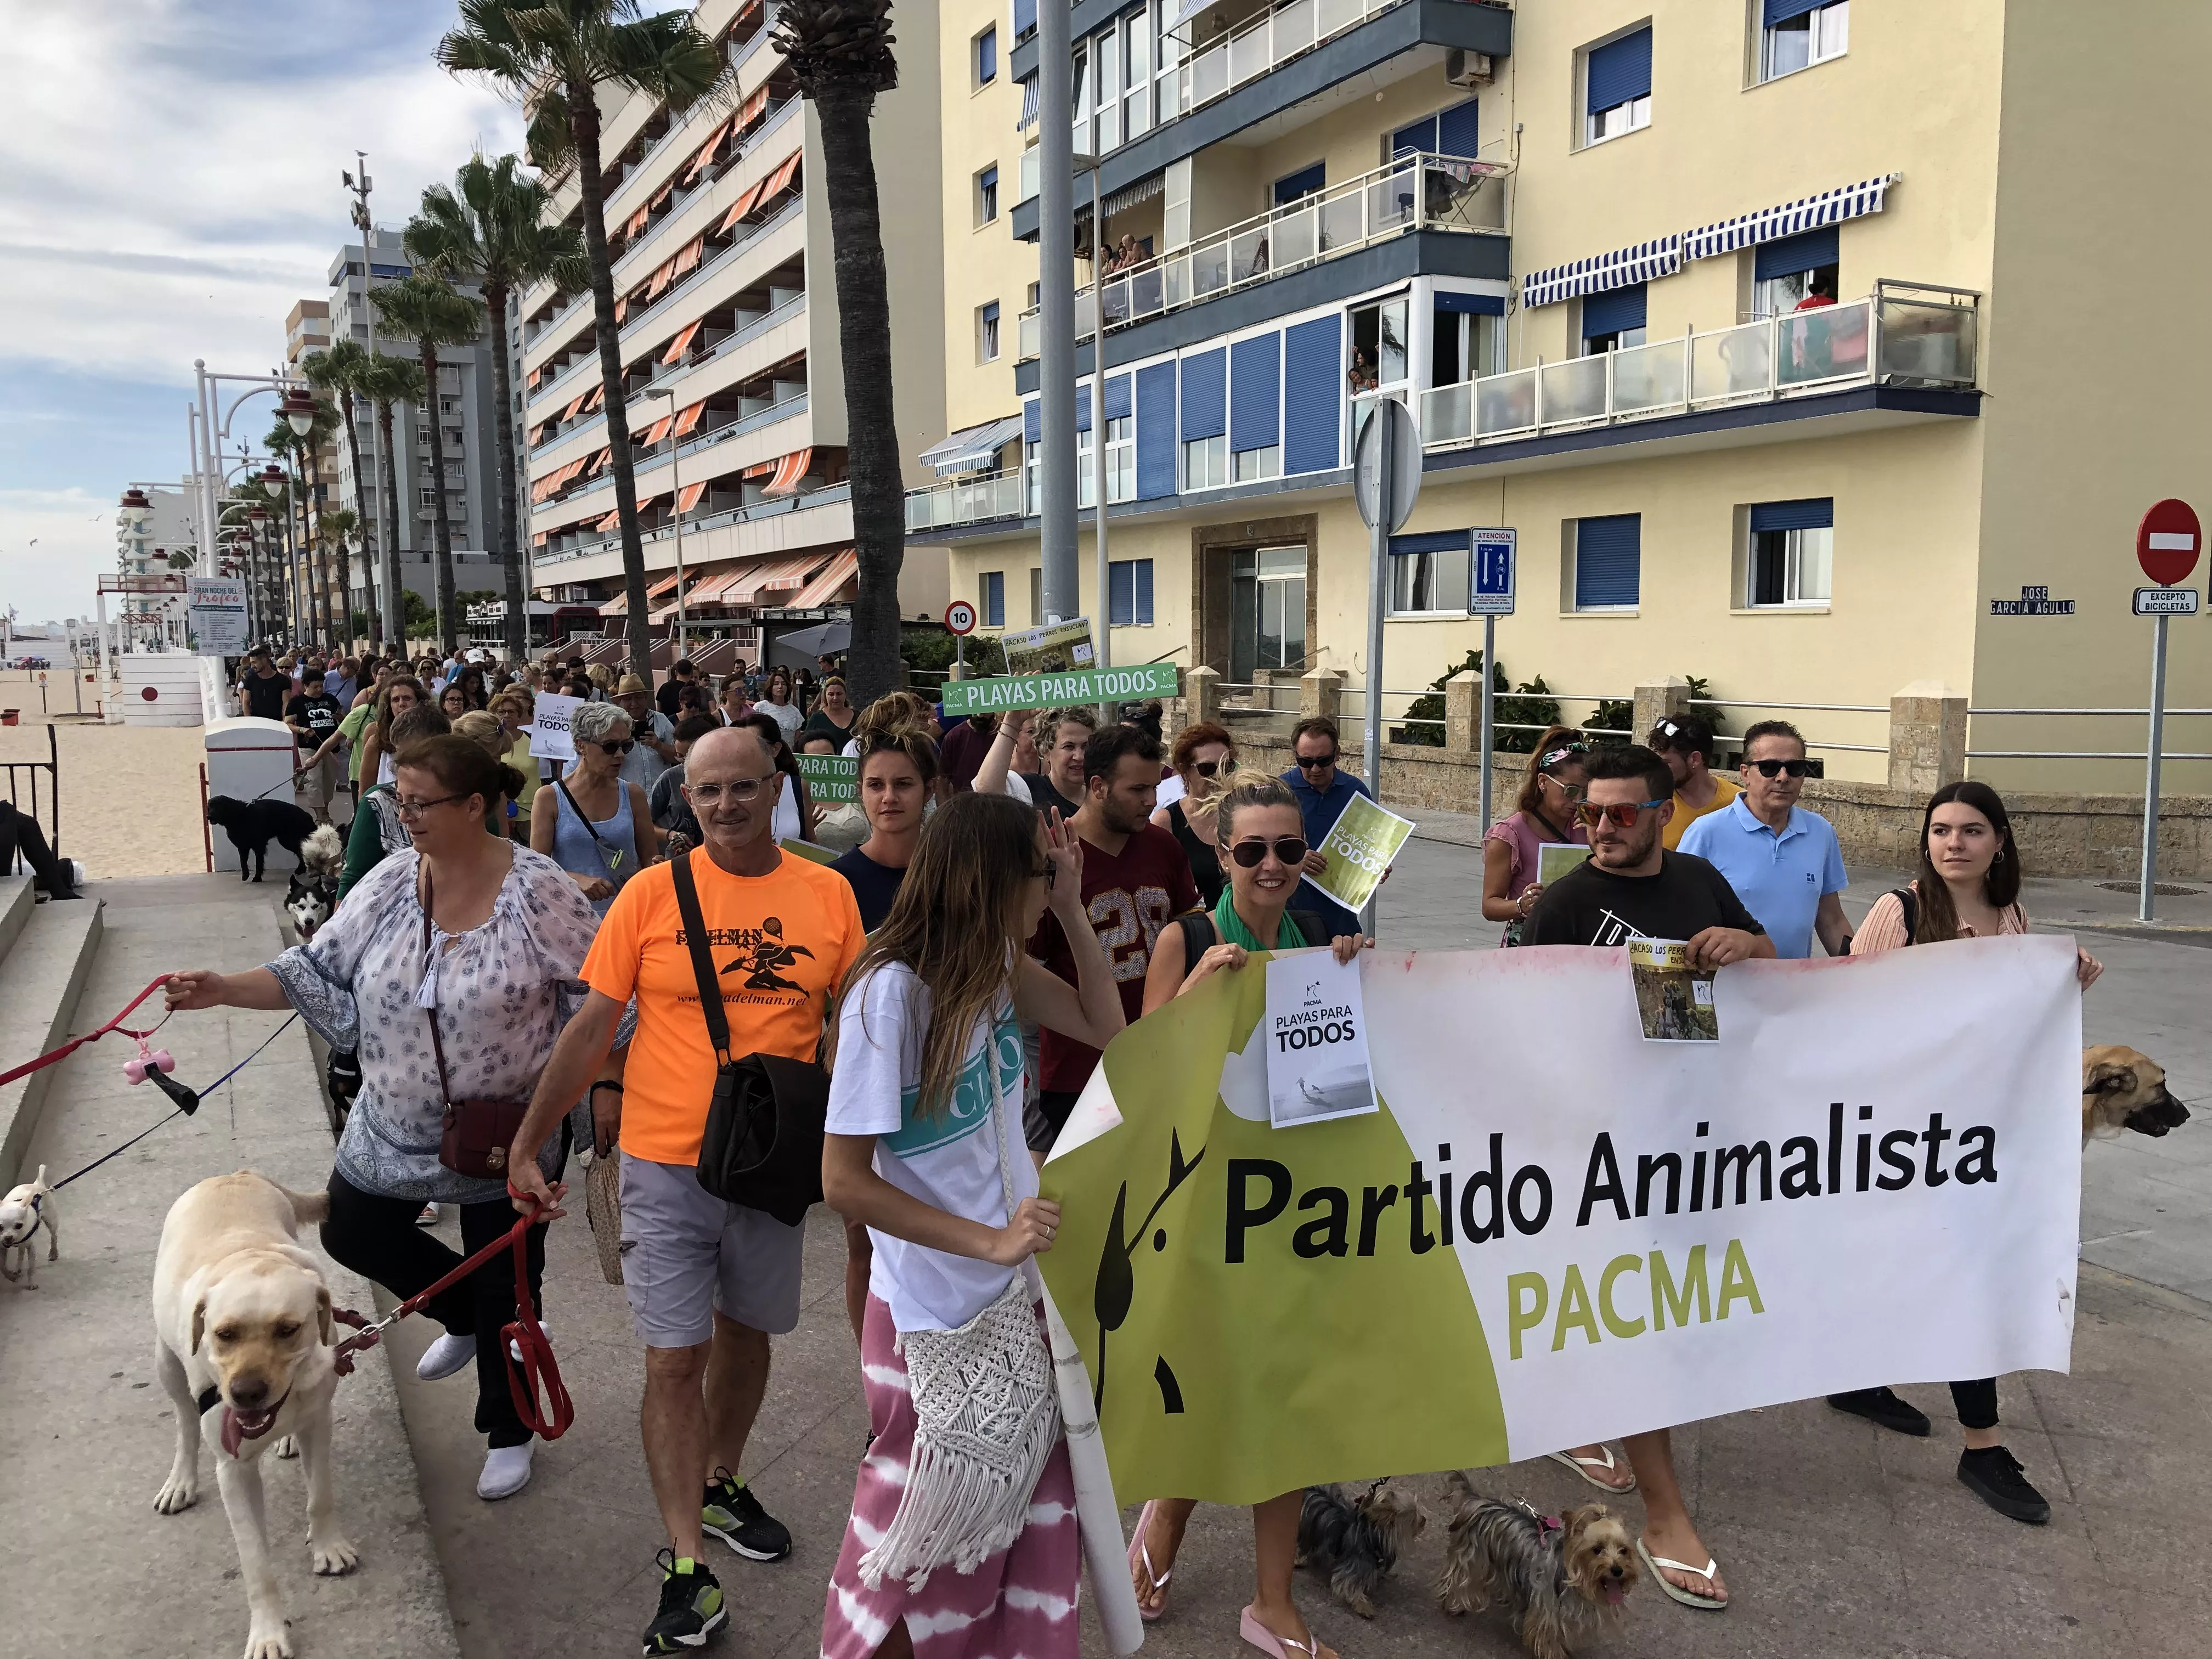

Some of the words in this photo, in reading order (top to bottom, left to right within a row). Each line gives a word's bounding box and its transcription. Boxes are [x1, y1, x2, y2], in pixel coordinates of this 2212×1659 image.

[2022, 588, 2047, 599] JOSE
[1990, 602, 2029, 614] GARCIA
[2036, 601, 2074, 614] AGULLO
[953, 612, 968, 624] 10
[1039, 629, 1058, 639] PERROS
[967, 681, 1036, 708] PLAYAS
[1041, 676, 1092, 701] PARA
[1094, 669, 1156, 696] TODOS
[539, 713, 561, 721] PLAYAS
[538, 719, 570, 732] TODO
[832, 760, 857, 776] TOD
[810, 782, 827, 798] RA
[831, 783, 856, 799] TOD
[1337, 825, 1369, 850] PLAYAS
[1367, 846, 1389, 862] PARA
[1330, 833, 1384, 874] TODOS
[1630, 940, 1653, 954] ¿ACASO
[1655, 945, 1666, 955] LOS
[1668, 946, 1686, 956] PERR
[1304, 998, 1322, 1007] PACMA
[1276, 1011, 1318, 1029] PLAYAS
[1321, 1005, 1353, 1020] PARA
[1276, 1019, 1355, 1053] TODOS
[1224, 1132, 1553, 1264] Partido
[1576, 1102, 1999, 1227] Animalista
[1506, 1238, 1765, 1361] PACMA
